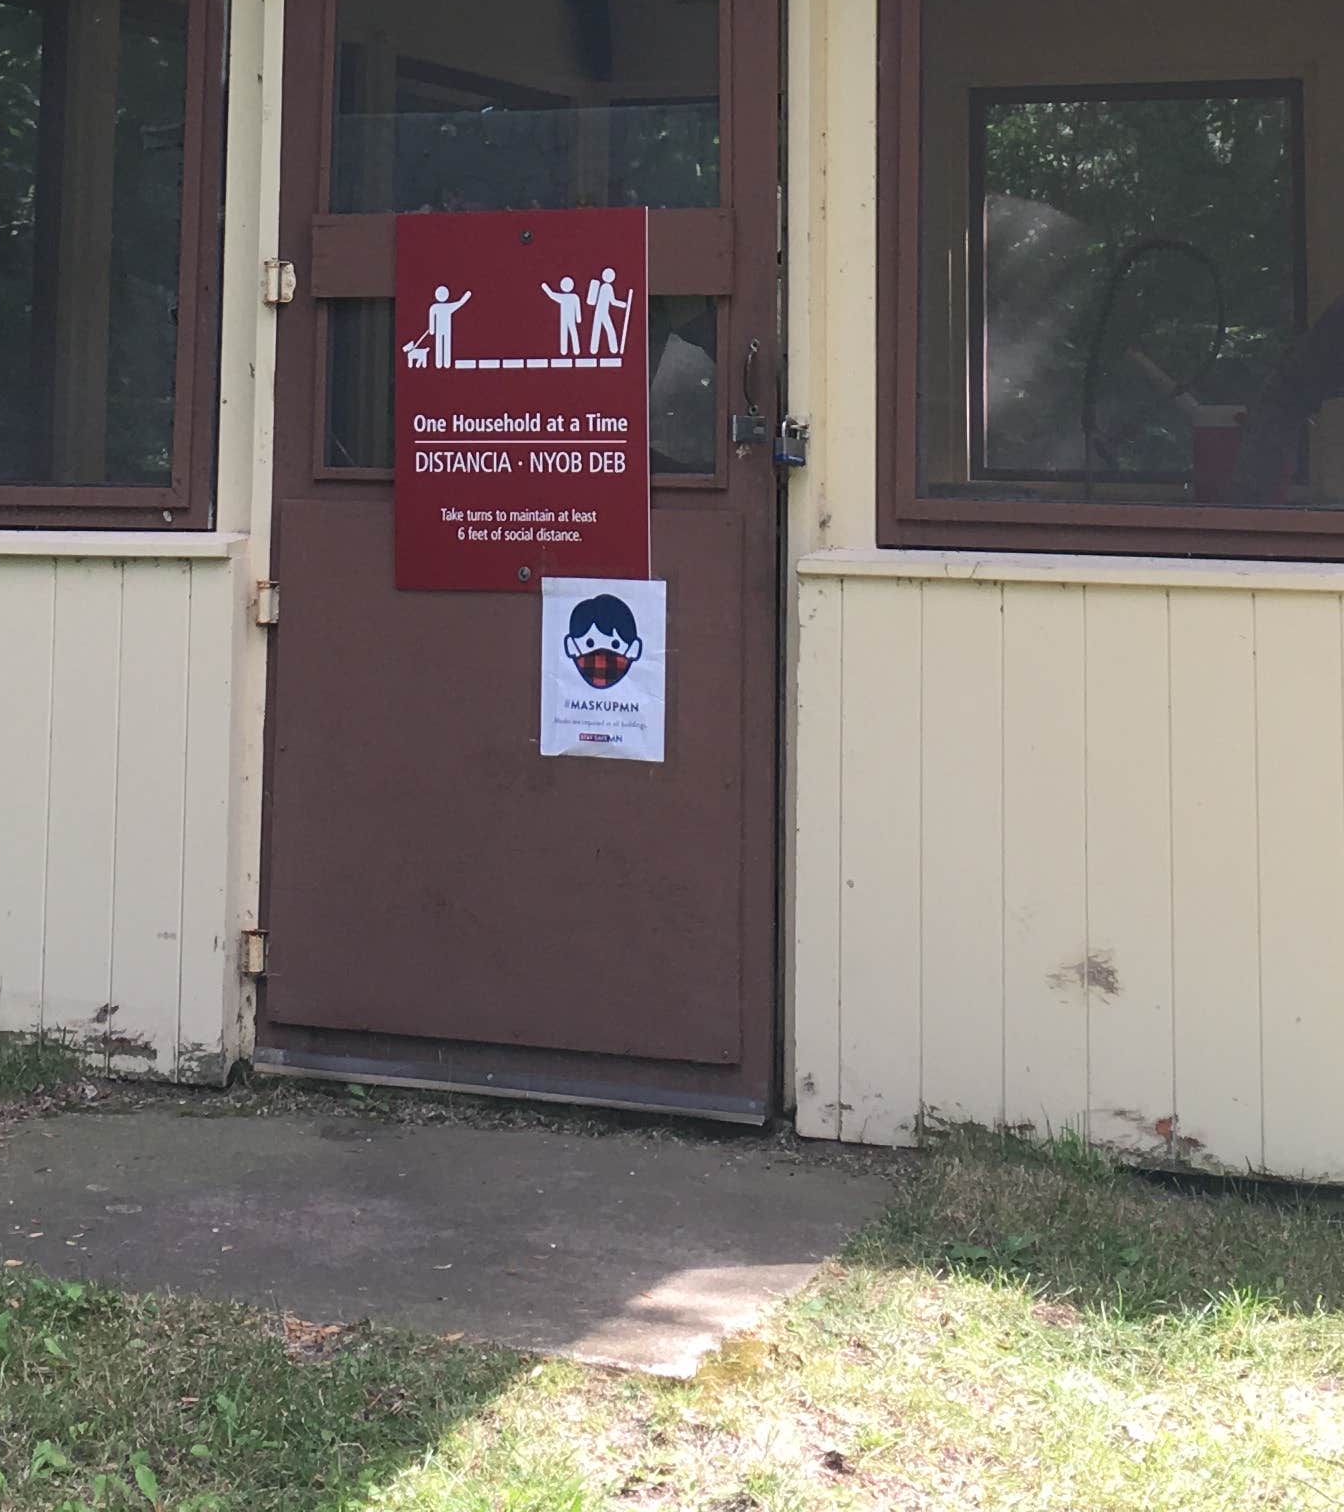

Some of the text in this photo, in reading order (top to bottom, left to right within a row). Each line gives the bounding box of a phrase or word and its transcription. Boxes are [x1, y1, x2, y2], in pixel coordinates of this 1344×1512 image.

[413, 413, 628, 433] One Household at a Time
[415, 451, 626, 473] DISTANCIA NYOB DEB
[440, 508, 597, 523] Take turns to maintain at least
[457, 526, 583, 542] 6 feet of social distance.
